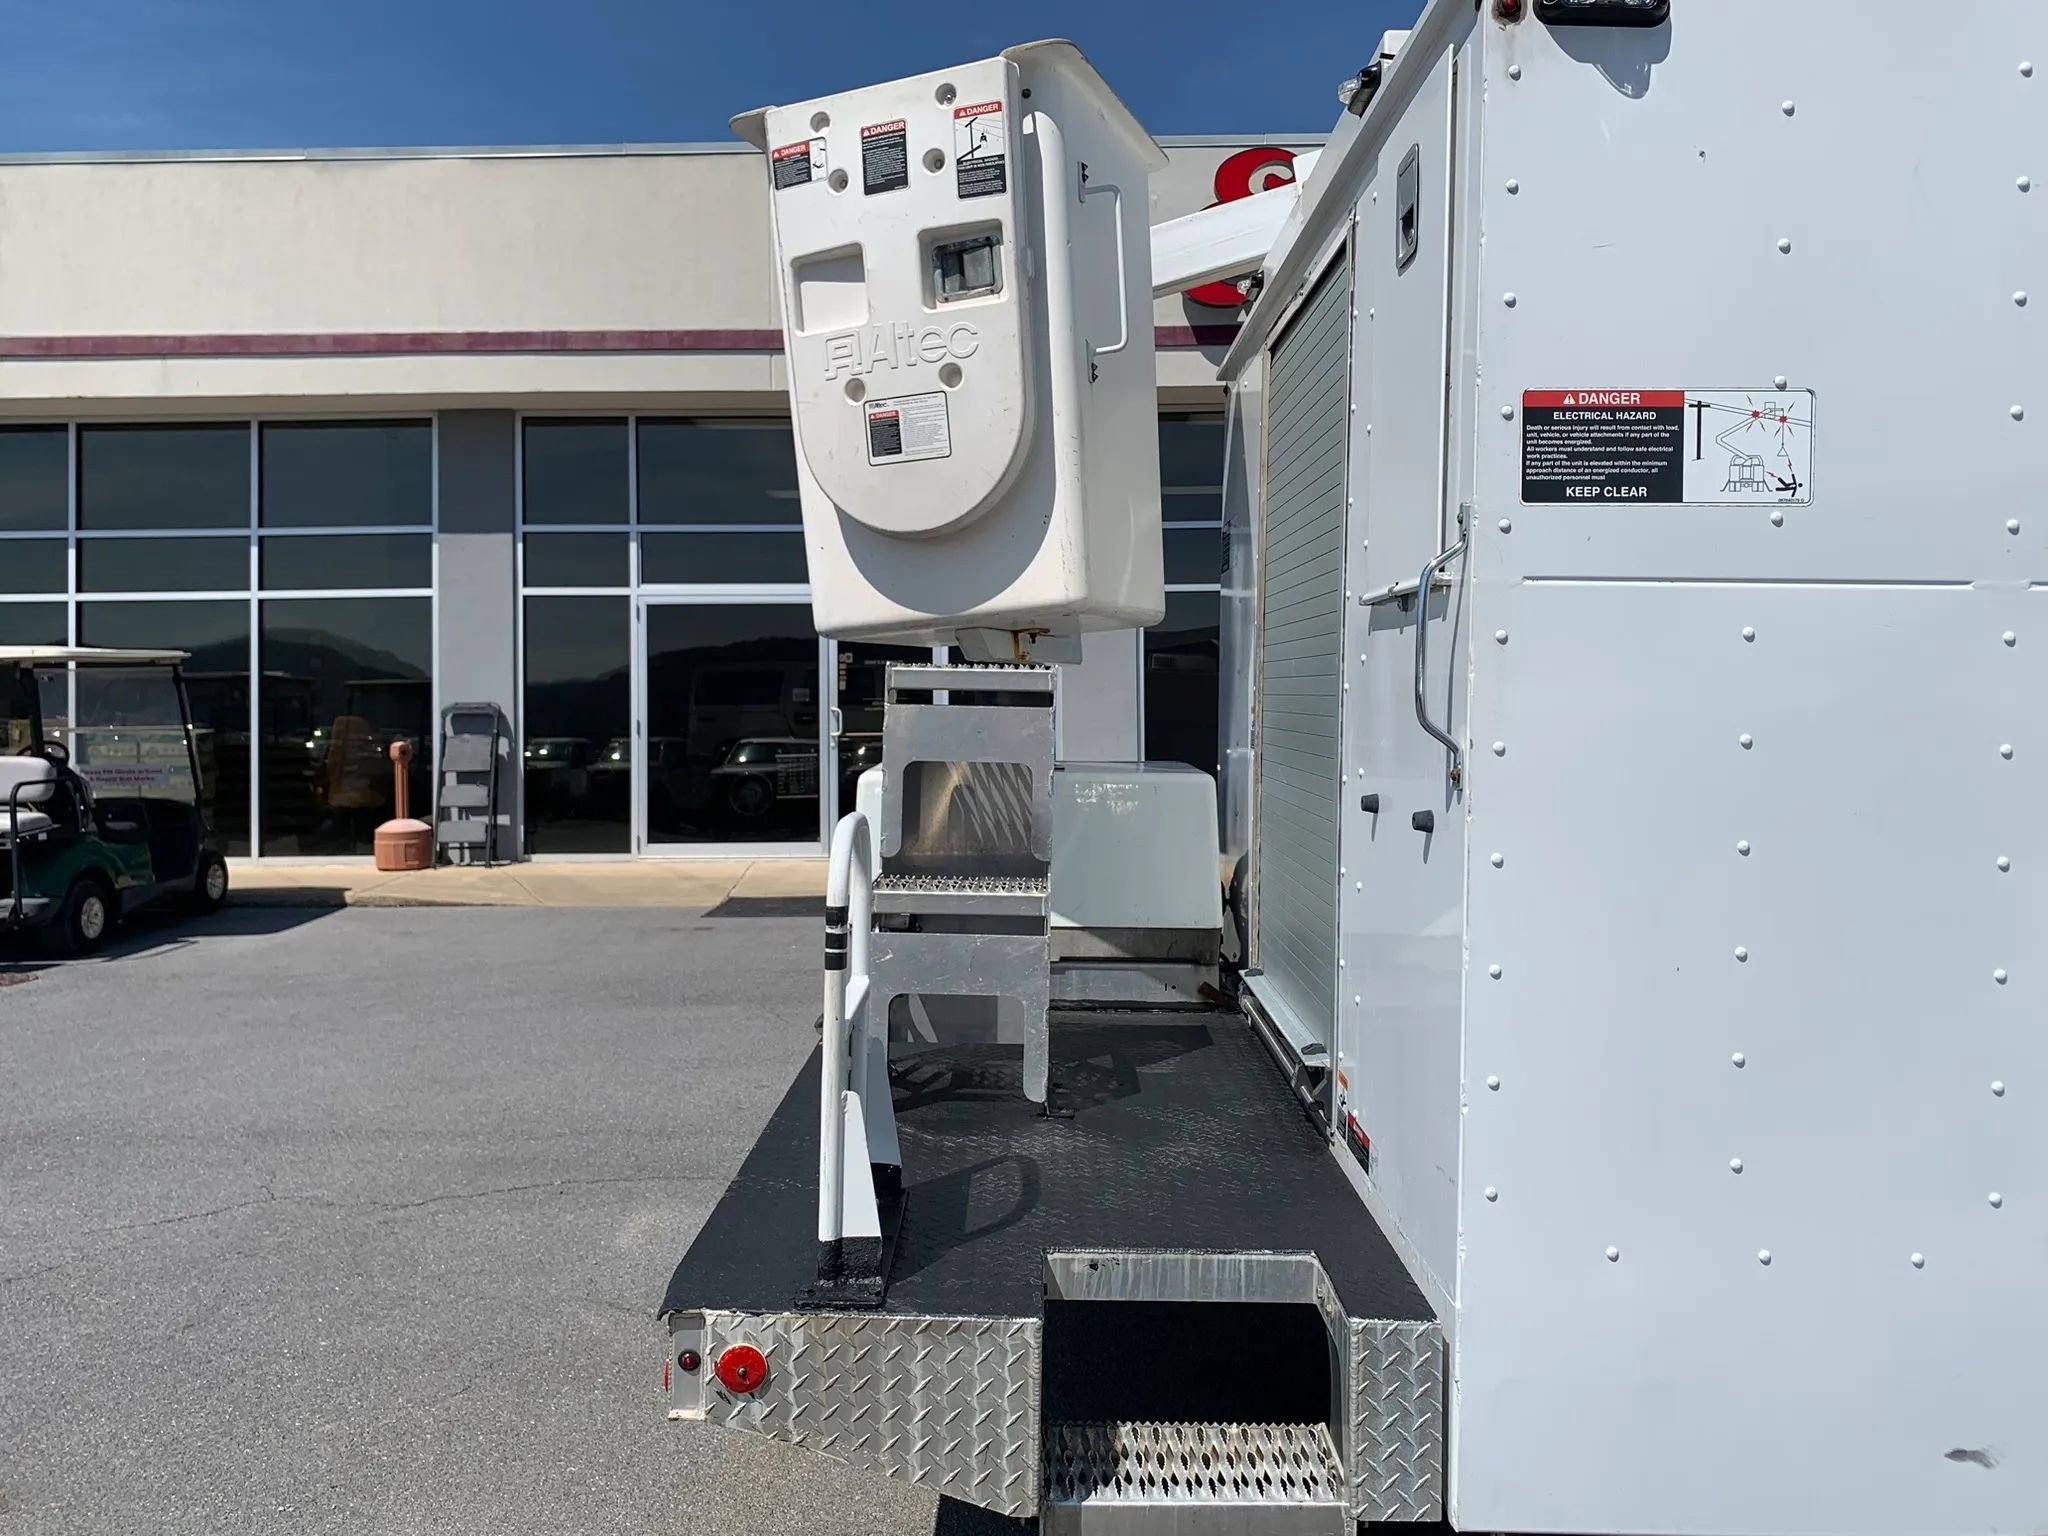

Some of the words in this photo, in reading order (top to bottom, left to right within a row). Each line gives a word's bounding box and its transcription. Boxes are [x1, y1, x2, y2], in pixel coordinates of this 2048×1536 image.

[965, 103, 999, 115] DANGER
[870, 121, 905, 135] DANGER
[781, 144, 806, 157] DANGER
[865, 320, 979, 374] Altec
[1579, 392, 1641, 405] DANGER
[1553, 411, 1613, 420] ELECTRICAL
[1616, 411, 1657, 420] HAZARD
[1566, 486, 1600, 497] KEEP
[1603, 486, 1648, 497] CLEAR
